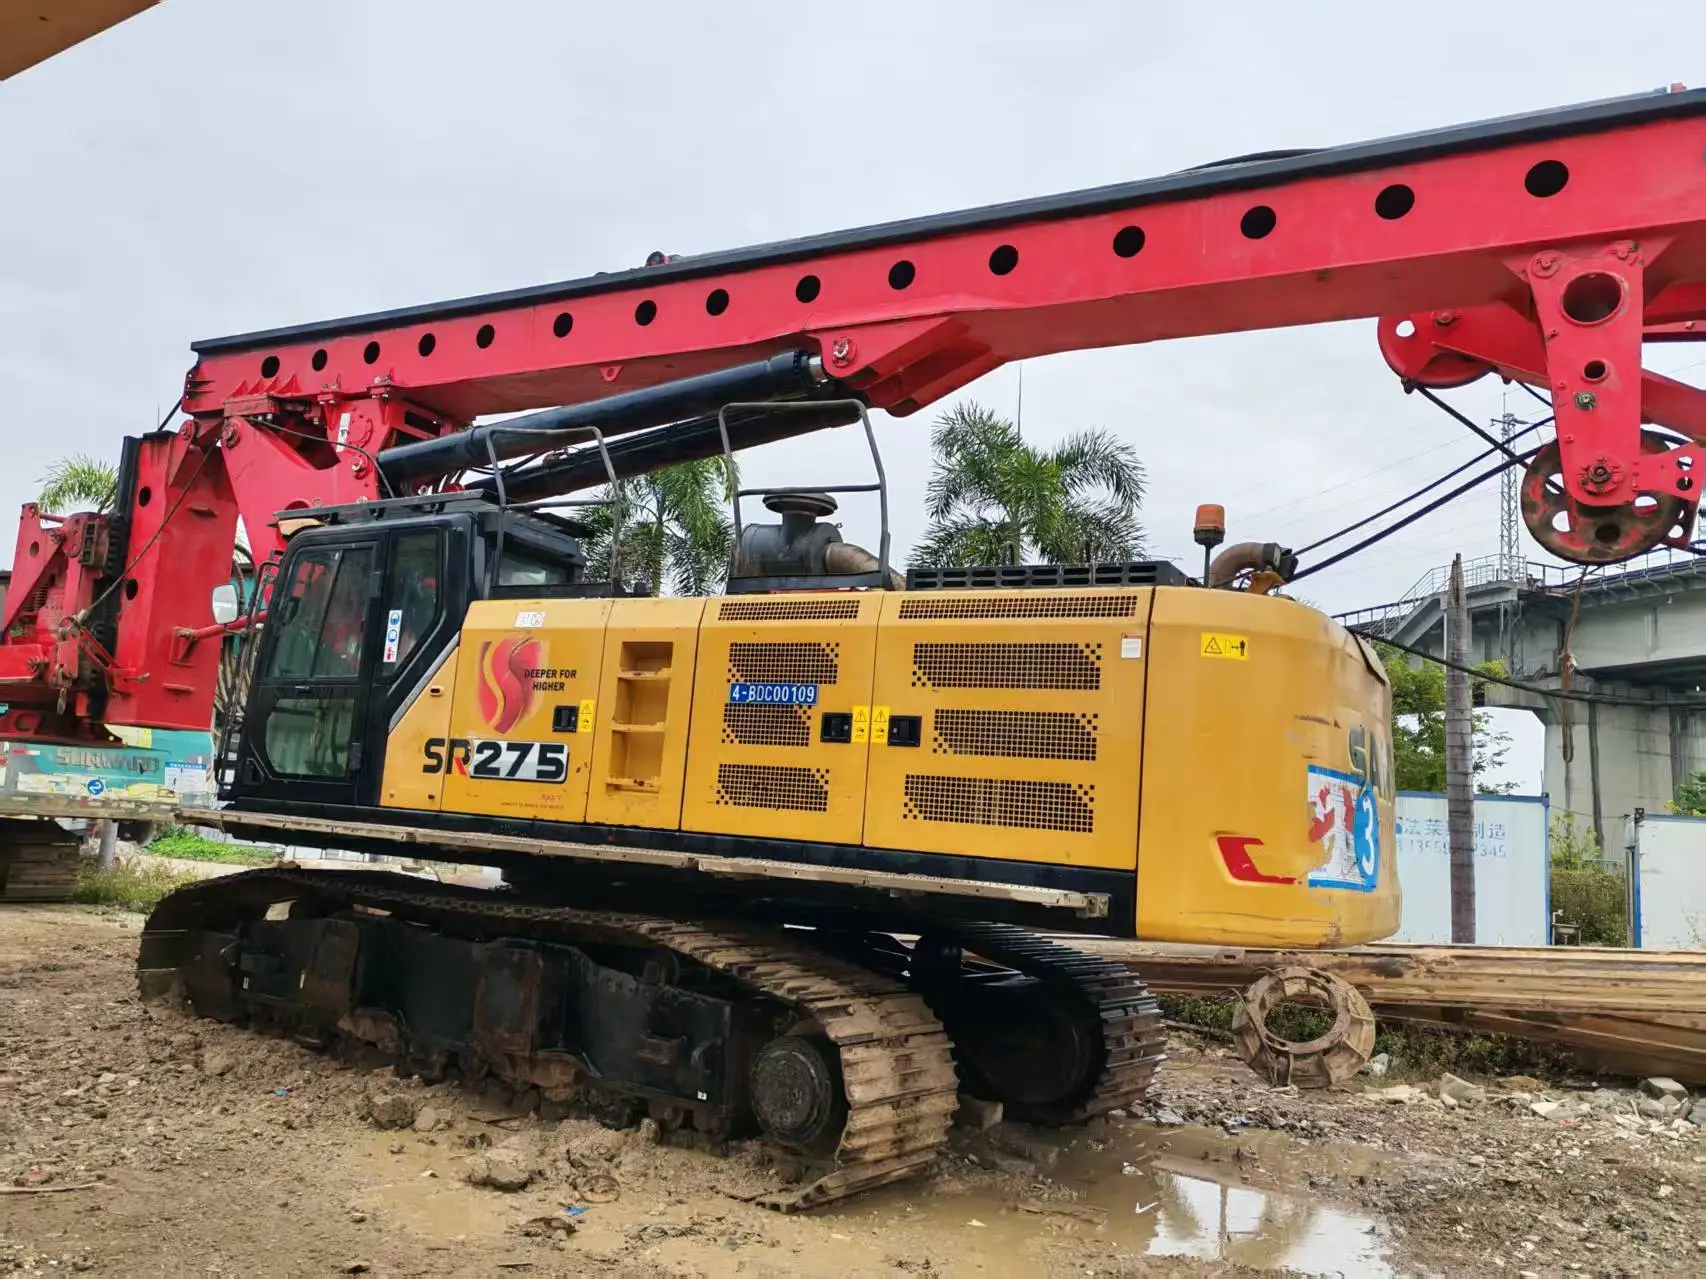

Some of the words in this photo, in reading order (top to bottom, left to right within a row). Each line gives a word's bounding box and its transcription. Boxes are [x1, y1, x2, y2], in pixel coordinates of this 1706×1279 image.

[524, 668, 557, 679] DEEPER
[559, 669, 577, 679] FOR
[533, 681, 565, 692] HIGHER
[732, 685, 815, 702] 4-BDC00109
